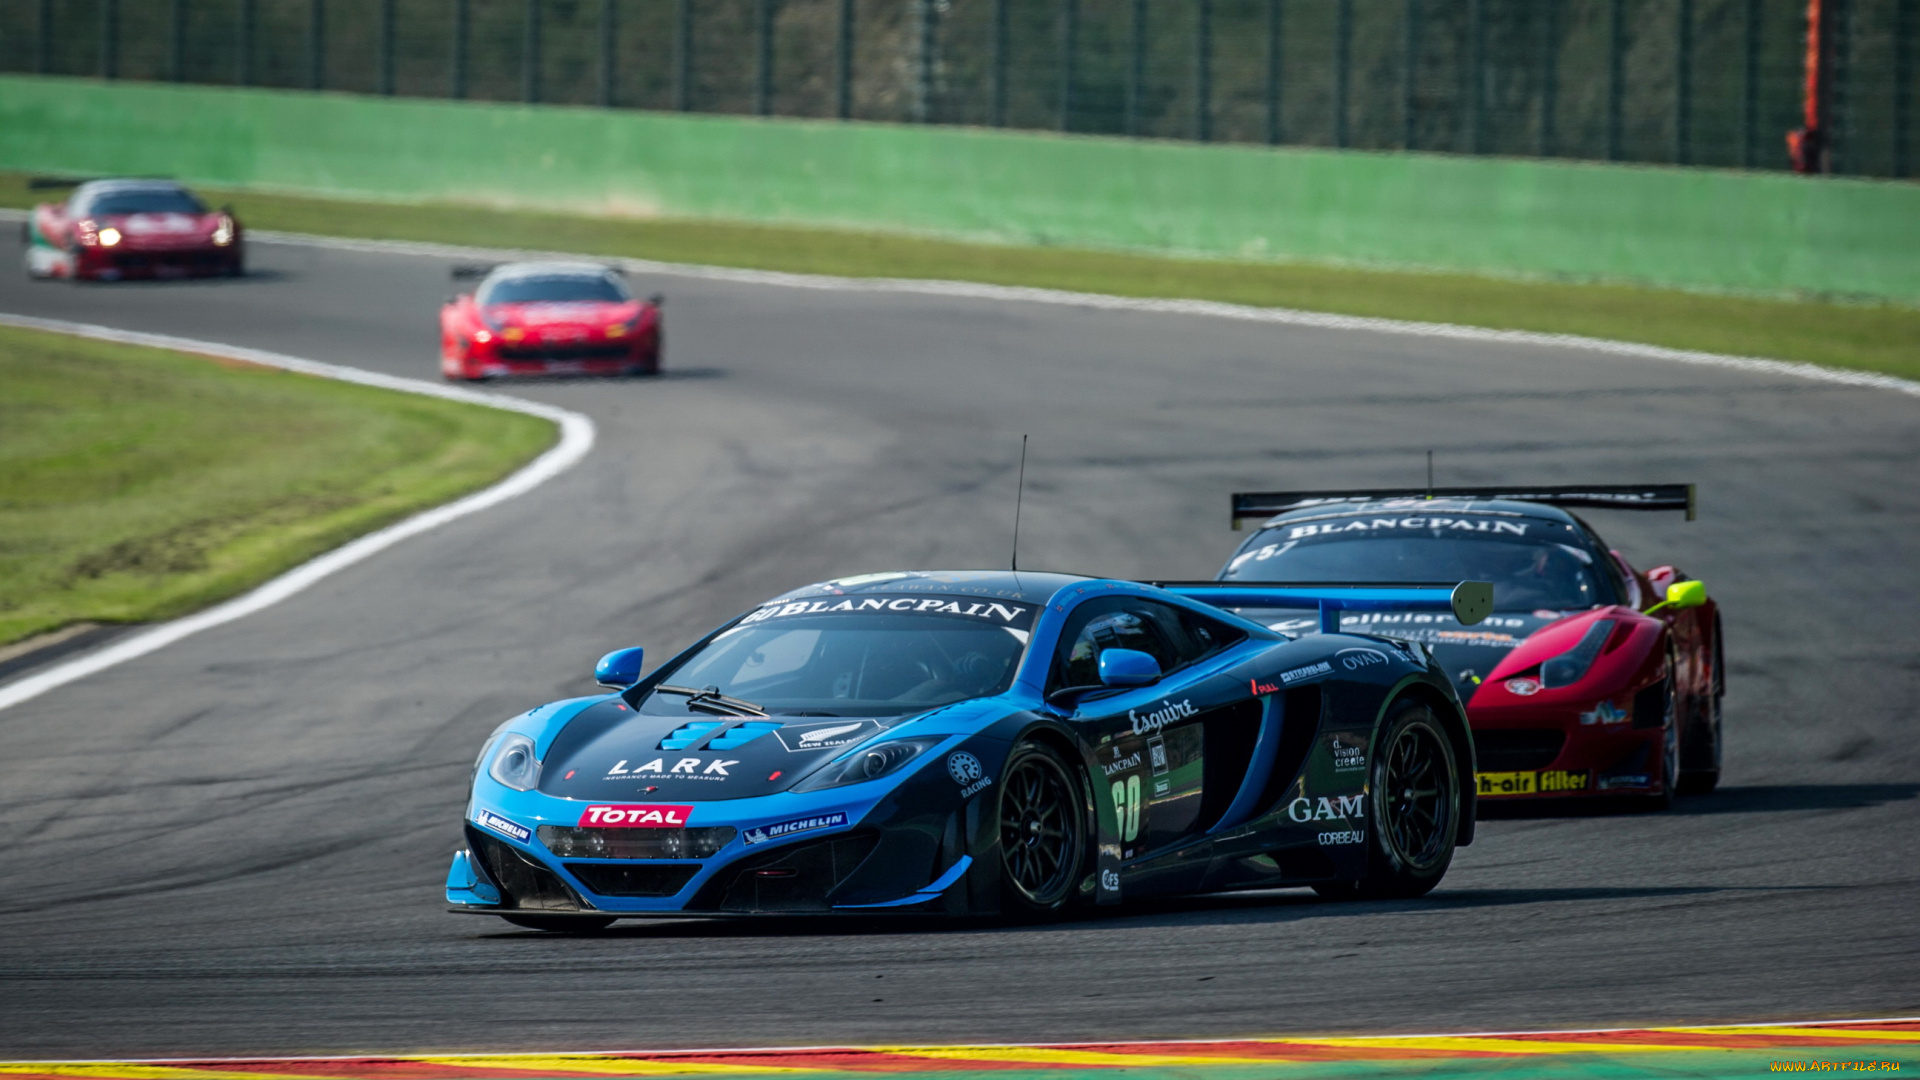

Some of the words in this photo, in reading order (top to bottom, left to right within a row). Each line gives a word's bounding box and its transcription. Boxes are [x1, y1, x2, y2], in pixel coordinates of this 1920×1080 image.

[1288, 517, 1530, 539] BLANCPAIN
[741, 605, 776, 624] 60
[774, 598, 1026, 622] BLANCPAIN
[1342, 652, 1383, 671] OVAL
[1258, 683, 1279, 694] PULL
[1128, 698, 1199, 736] Esquire
[1334, 747, 1360, 757] vision
[1335, 756, 1365, 767] create
[607, 758, 740, 776] LARK
[1101, 751, 1141, 775] LANCPAIN
[685, 774, 726, 782] MEASURE
[960, 776, 992, 798] RACING
[1540, 771, 1587, 791] filter
[588, 806, 683, 824] TOTAL
[1288, 794, 1364, 823] GAM
[488, 814, 529, 840] MICHELIN
[769, 814, 843, 836] MICHELIN
[1318, 830, 1364, 845] CORBEAU
